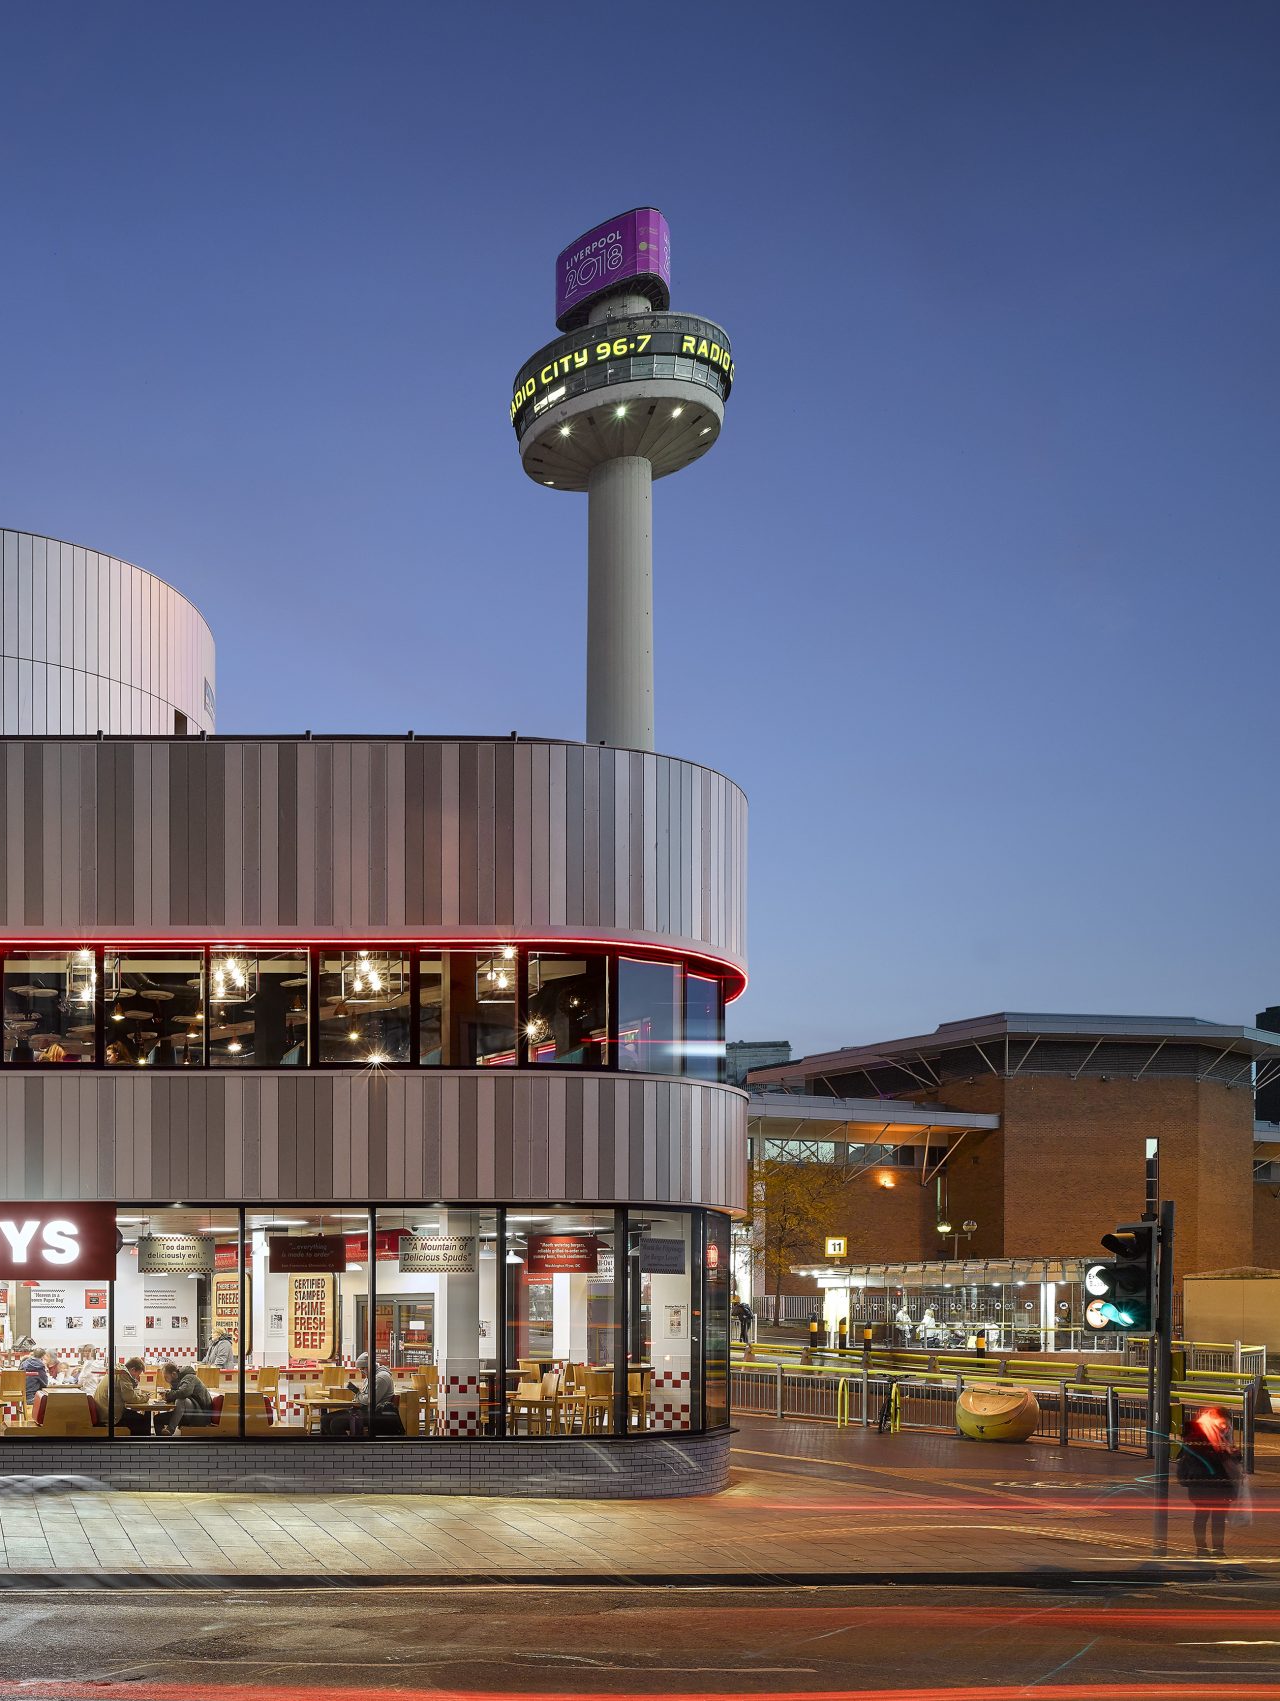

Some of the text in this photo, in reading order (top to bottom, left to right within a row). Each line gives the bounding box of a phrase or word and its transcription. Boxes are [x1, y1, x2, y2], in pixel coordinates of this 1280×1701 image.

[566, 231, 622, 270] LIVERPOOL
[565, 243, 622, 299] 2018
[682, 335, 730, 371] RADIO
[541, 347, 588, 385] CITY
[832, 1242, 842, 1251] 11
[404, 1253, 472, 1262] Delicious Spuds"
[294, 1279, 326, 1289] CERTIFIED
[294, 1291, 326, 1300] STAMPED
[294, 1302, 326, 1315] PRIME
[294, 1317, 326, 1330] FRESH
[294, 1332, 326, 1349] BEEF
